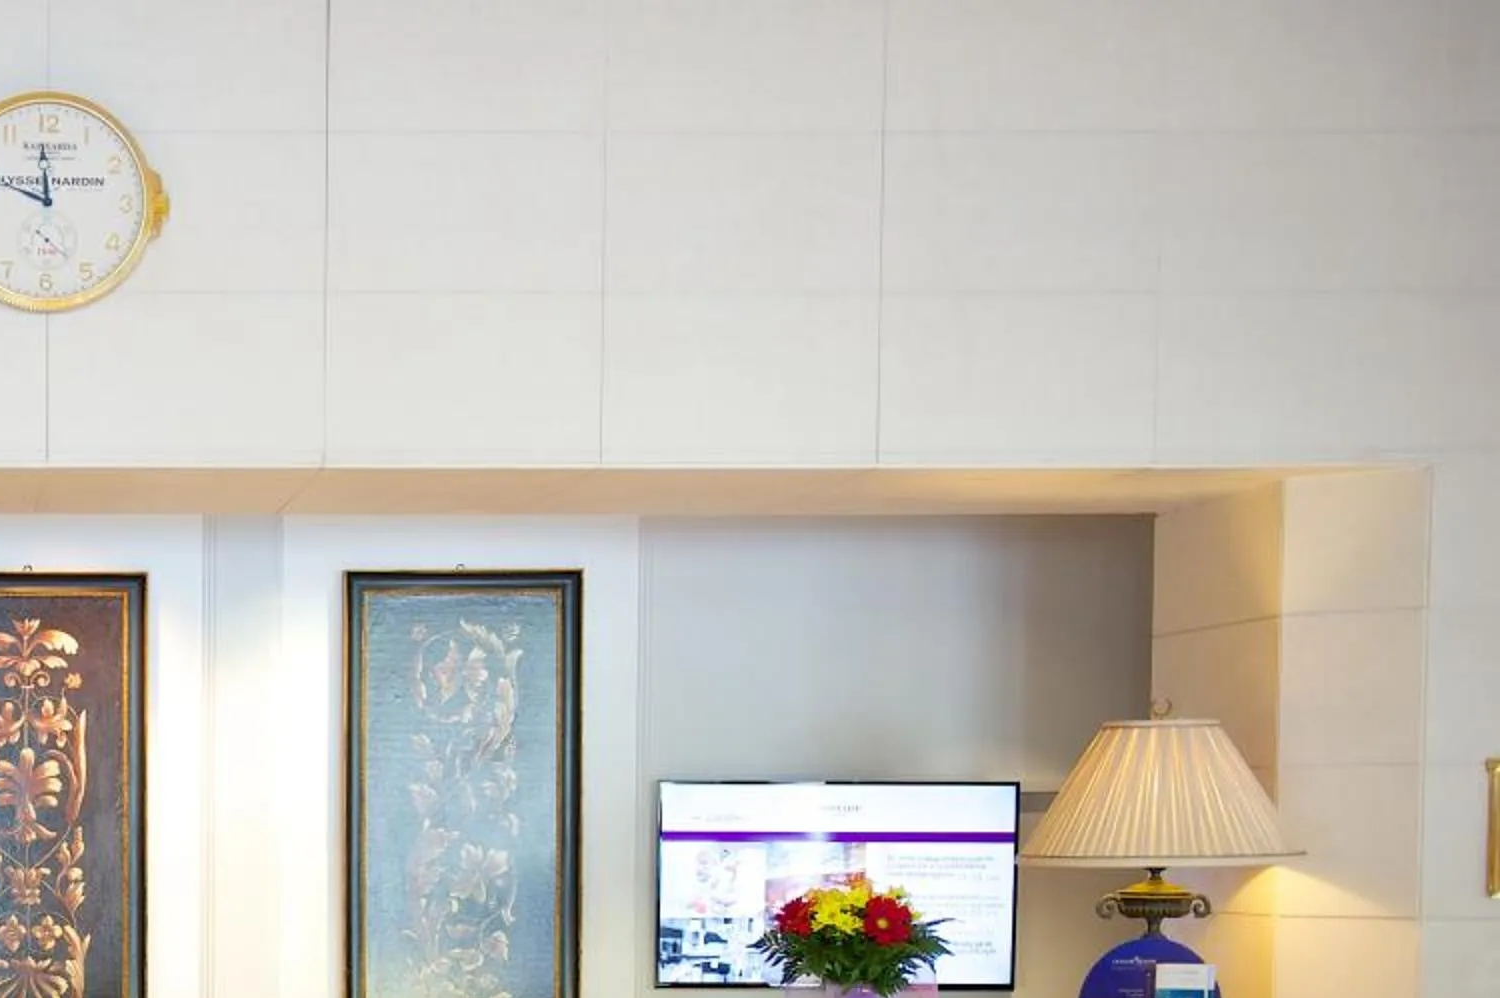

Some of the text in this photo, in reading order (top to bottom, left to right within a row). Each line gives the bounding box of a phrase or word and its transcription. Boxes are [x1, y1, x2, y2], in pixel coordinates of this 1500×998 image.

[38, 114, 60, 134] 12
[3, 124, 17, 145] 11
[108, 155, 122, 174] 2
[51, 176, 105, 187] NARDIN
[119, 193, 133, 214] 3
[105, 233, 120, 251] 4
[0, 260, 14, 279] 7
[79, 262, 93, 282] 5
[39, 273, 53, 291] 6
